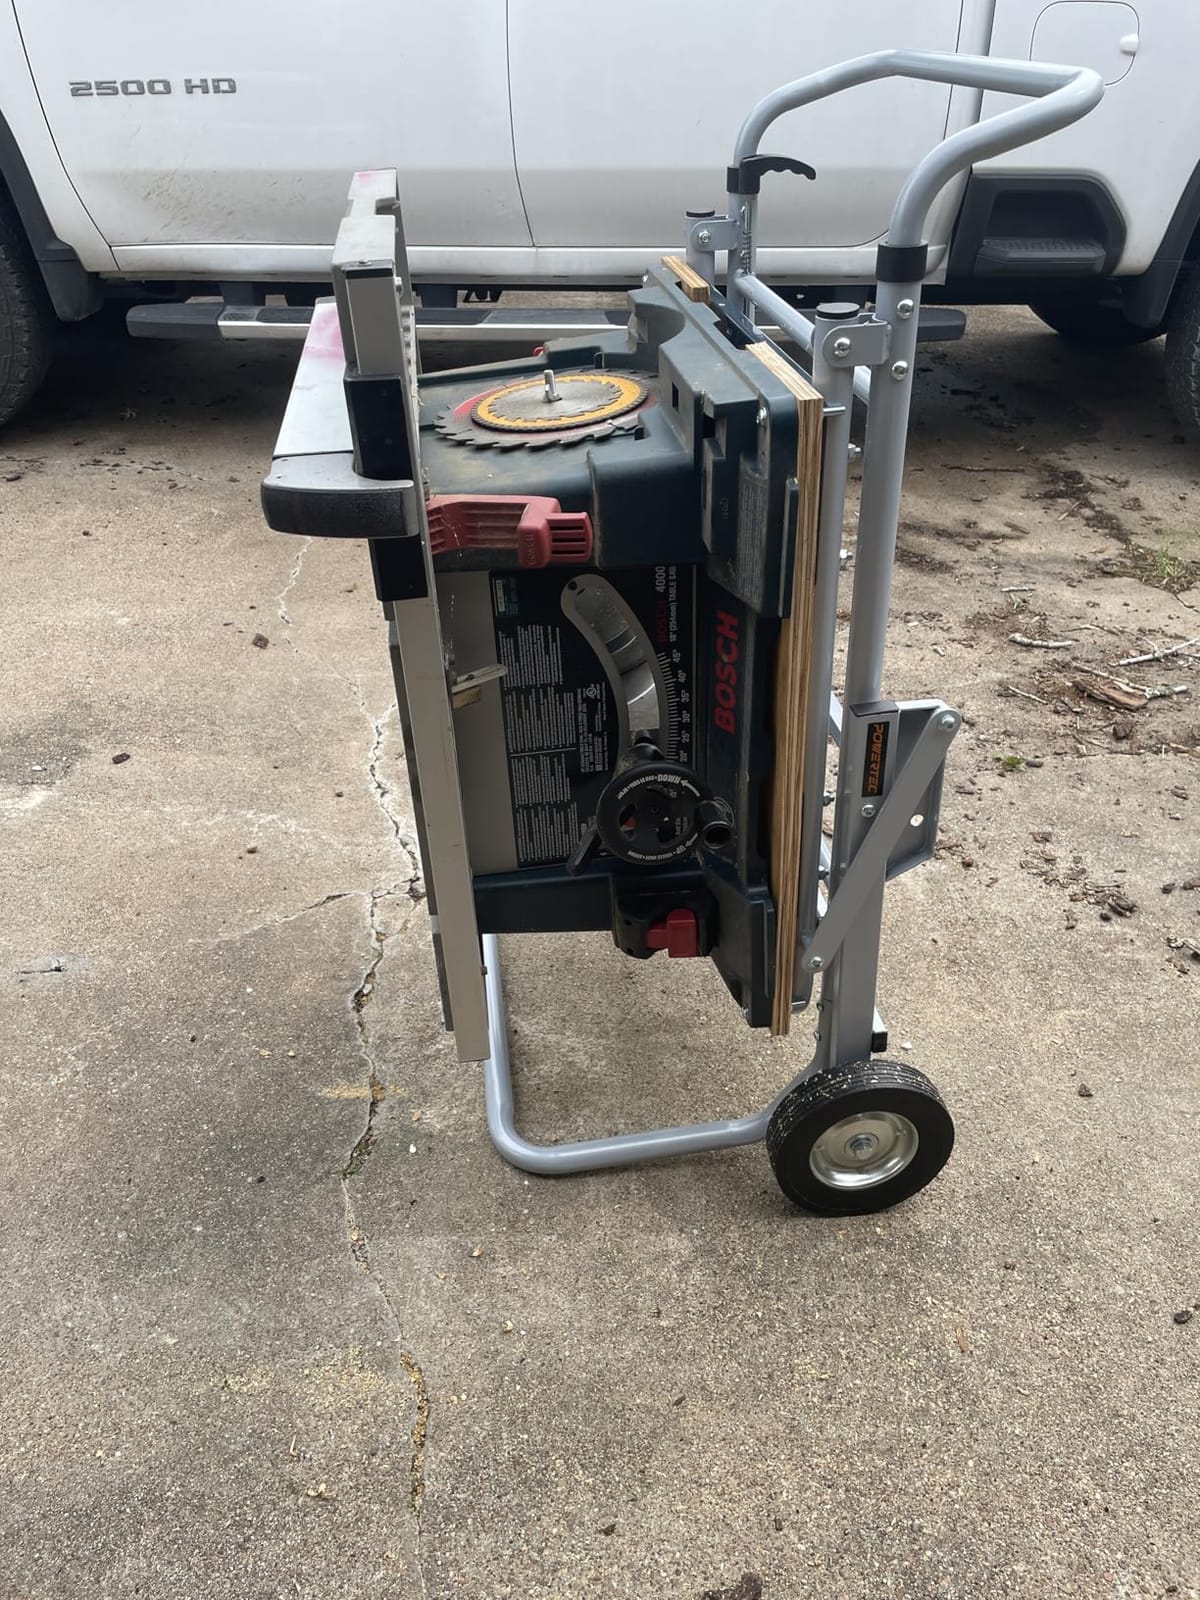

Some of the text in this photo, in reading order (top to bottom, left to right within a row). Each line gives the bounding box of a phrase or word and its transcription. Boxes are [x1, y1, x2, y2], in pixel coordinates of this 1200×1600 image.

[69, 78, 237, 97] 2500 HD
[655, 566, 666, 593] 4000
[714, 610, 739, 734] BOSCH
[867, 723, 884, 793] POWERTEC
[657, 774, 682, 784] DOWN
